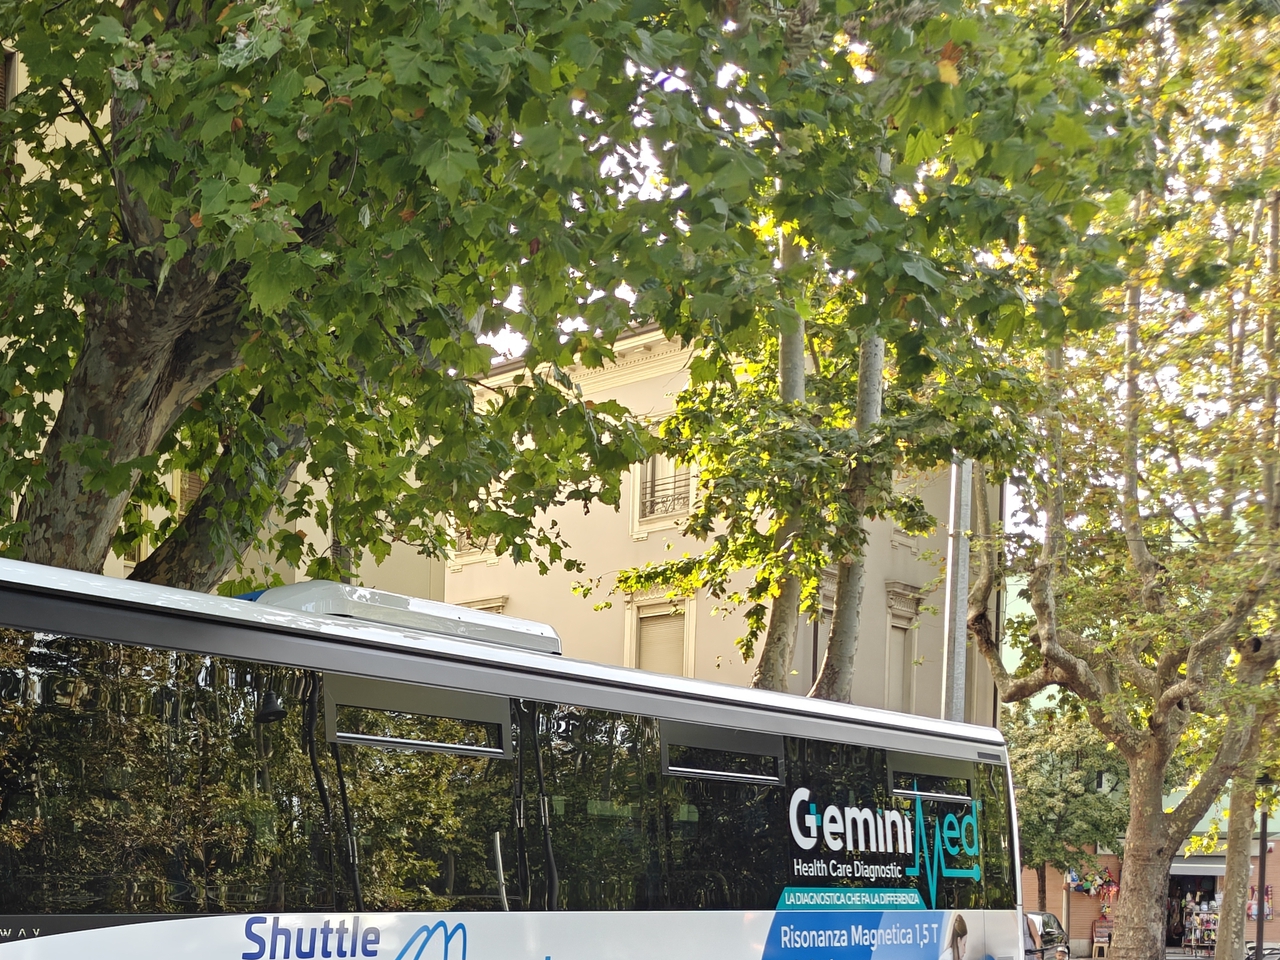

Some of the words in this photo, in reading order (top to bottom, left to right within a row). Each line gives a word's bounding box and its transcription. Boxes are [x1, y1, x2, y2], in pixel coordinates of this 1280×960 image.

[793, 859, 827, 876] Health
[829, 860, 852, 876] Care
[853, 861, 902, 881] Diagnostic
[785, 893, 795, 904] LA
[795, 893, 845, 904] DIAGNOSTICA
[846, 893, 861, 904] CHE
[861, 893, 870, 905] FA
[870, 893, 880, 905] LA
[880, 893, 919, 905] DIFFERENZA
[242, 916, 380, 960] Shuttle
[781, 925, 848, 949] Risonanza
[850, 923, 913, 951] Magnetica
[914, 924, 930, 948] 1,5
[931, 924, 939, 943] T
